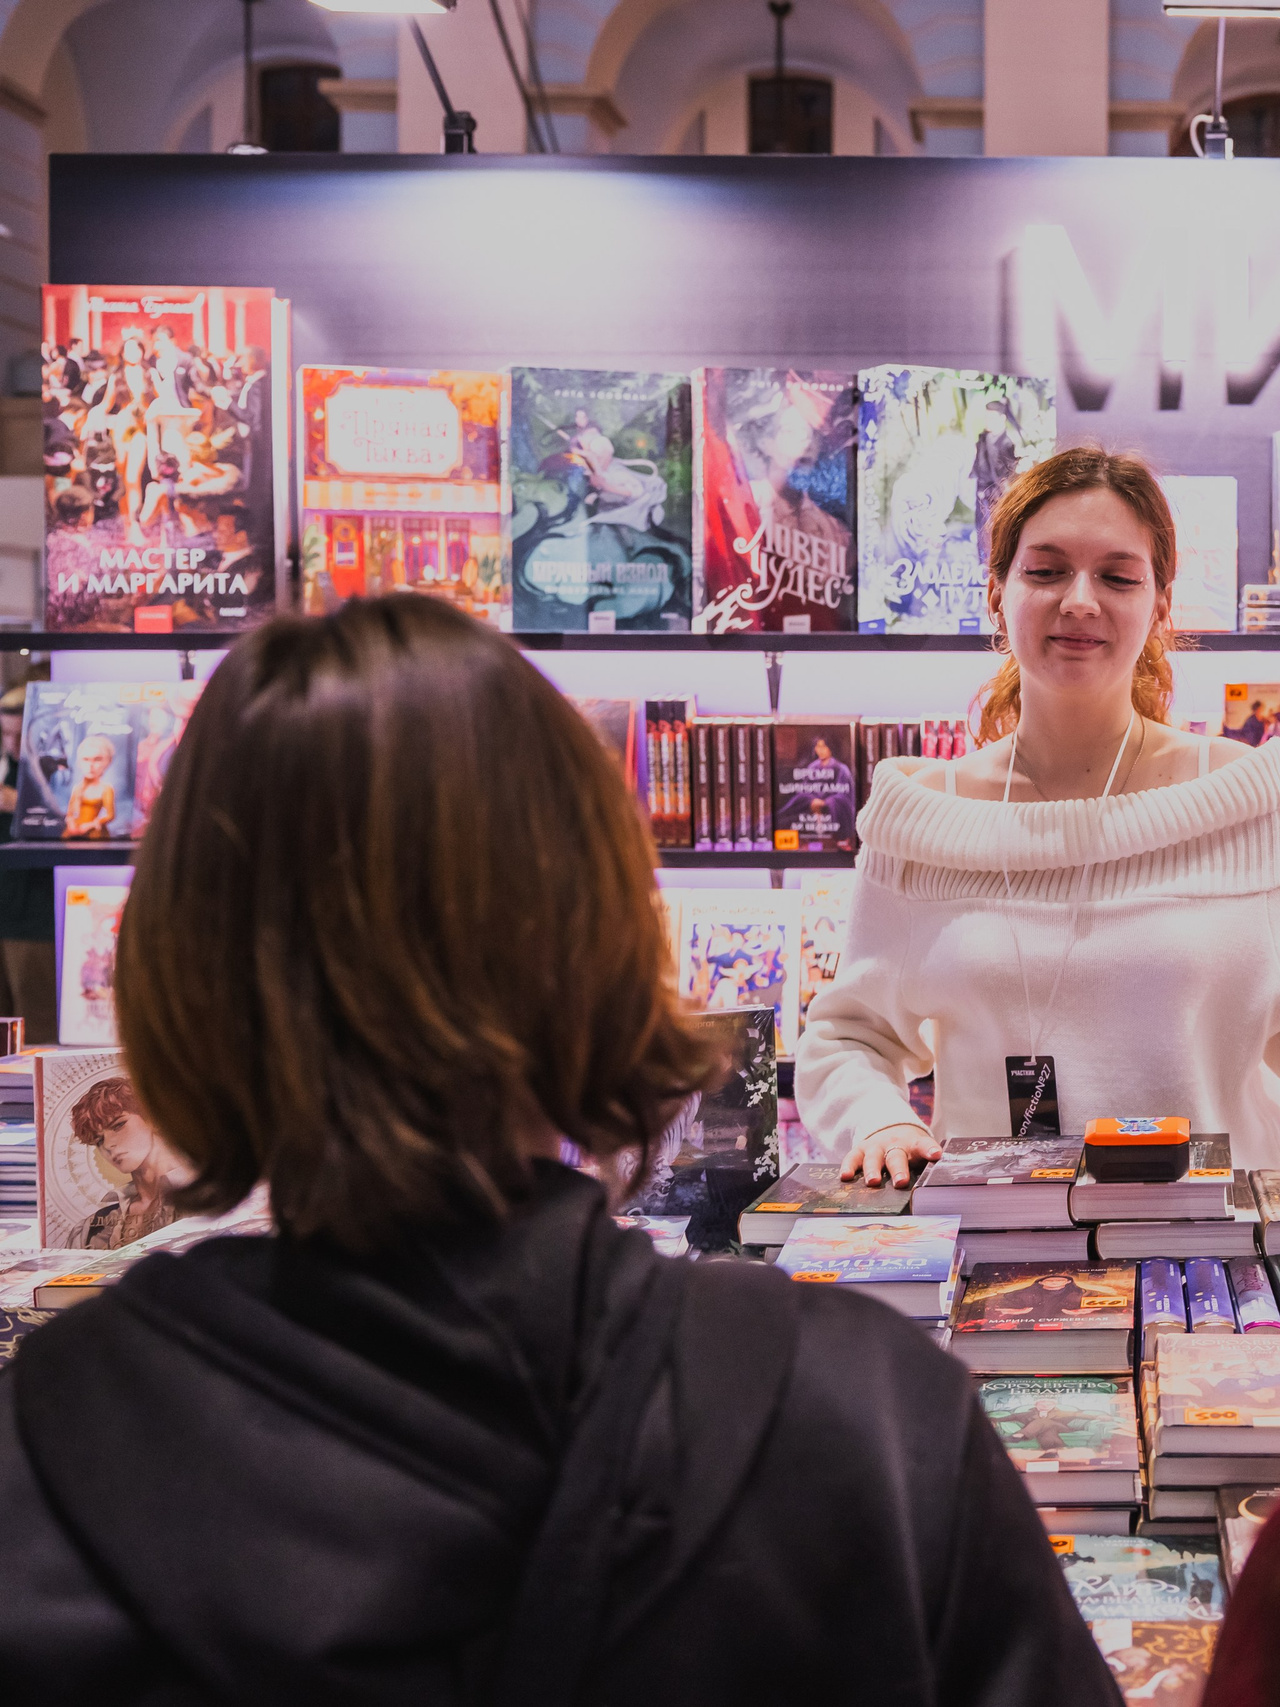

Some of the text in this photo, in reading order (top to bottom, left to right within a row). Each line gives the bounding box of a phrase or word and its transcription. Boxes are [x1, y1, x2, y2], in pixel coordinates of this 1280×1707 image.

[99, 548, 206, 570] МАСТЕР
[733, 506, 852, 594] ЛОВЕЦ
[57, 572, 248, 594] И МАРГАРИТА
[736, 545, 842, 611] ЧУДЕС
[800, 1257, 928, 1269] КИОКО
[982, 1382, 1111, 1391] КОРОЛЕВСТВО
